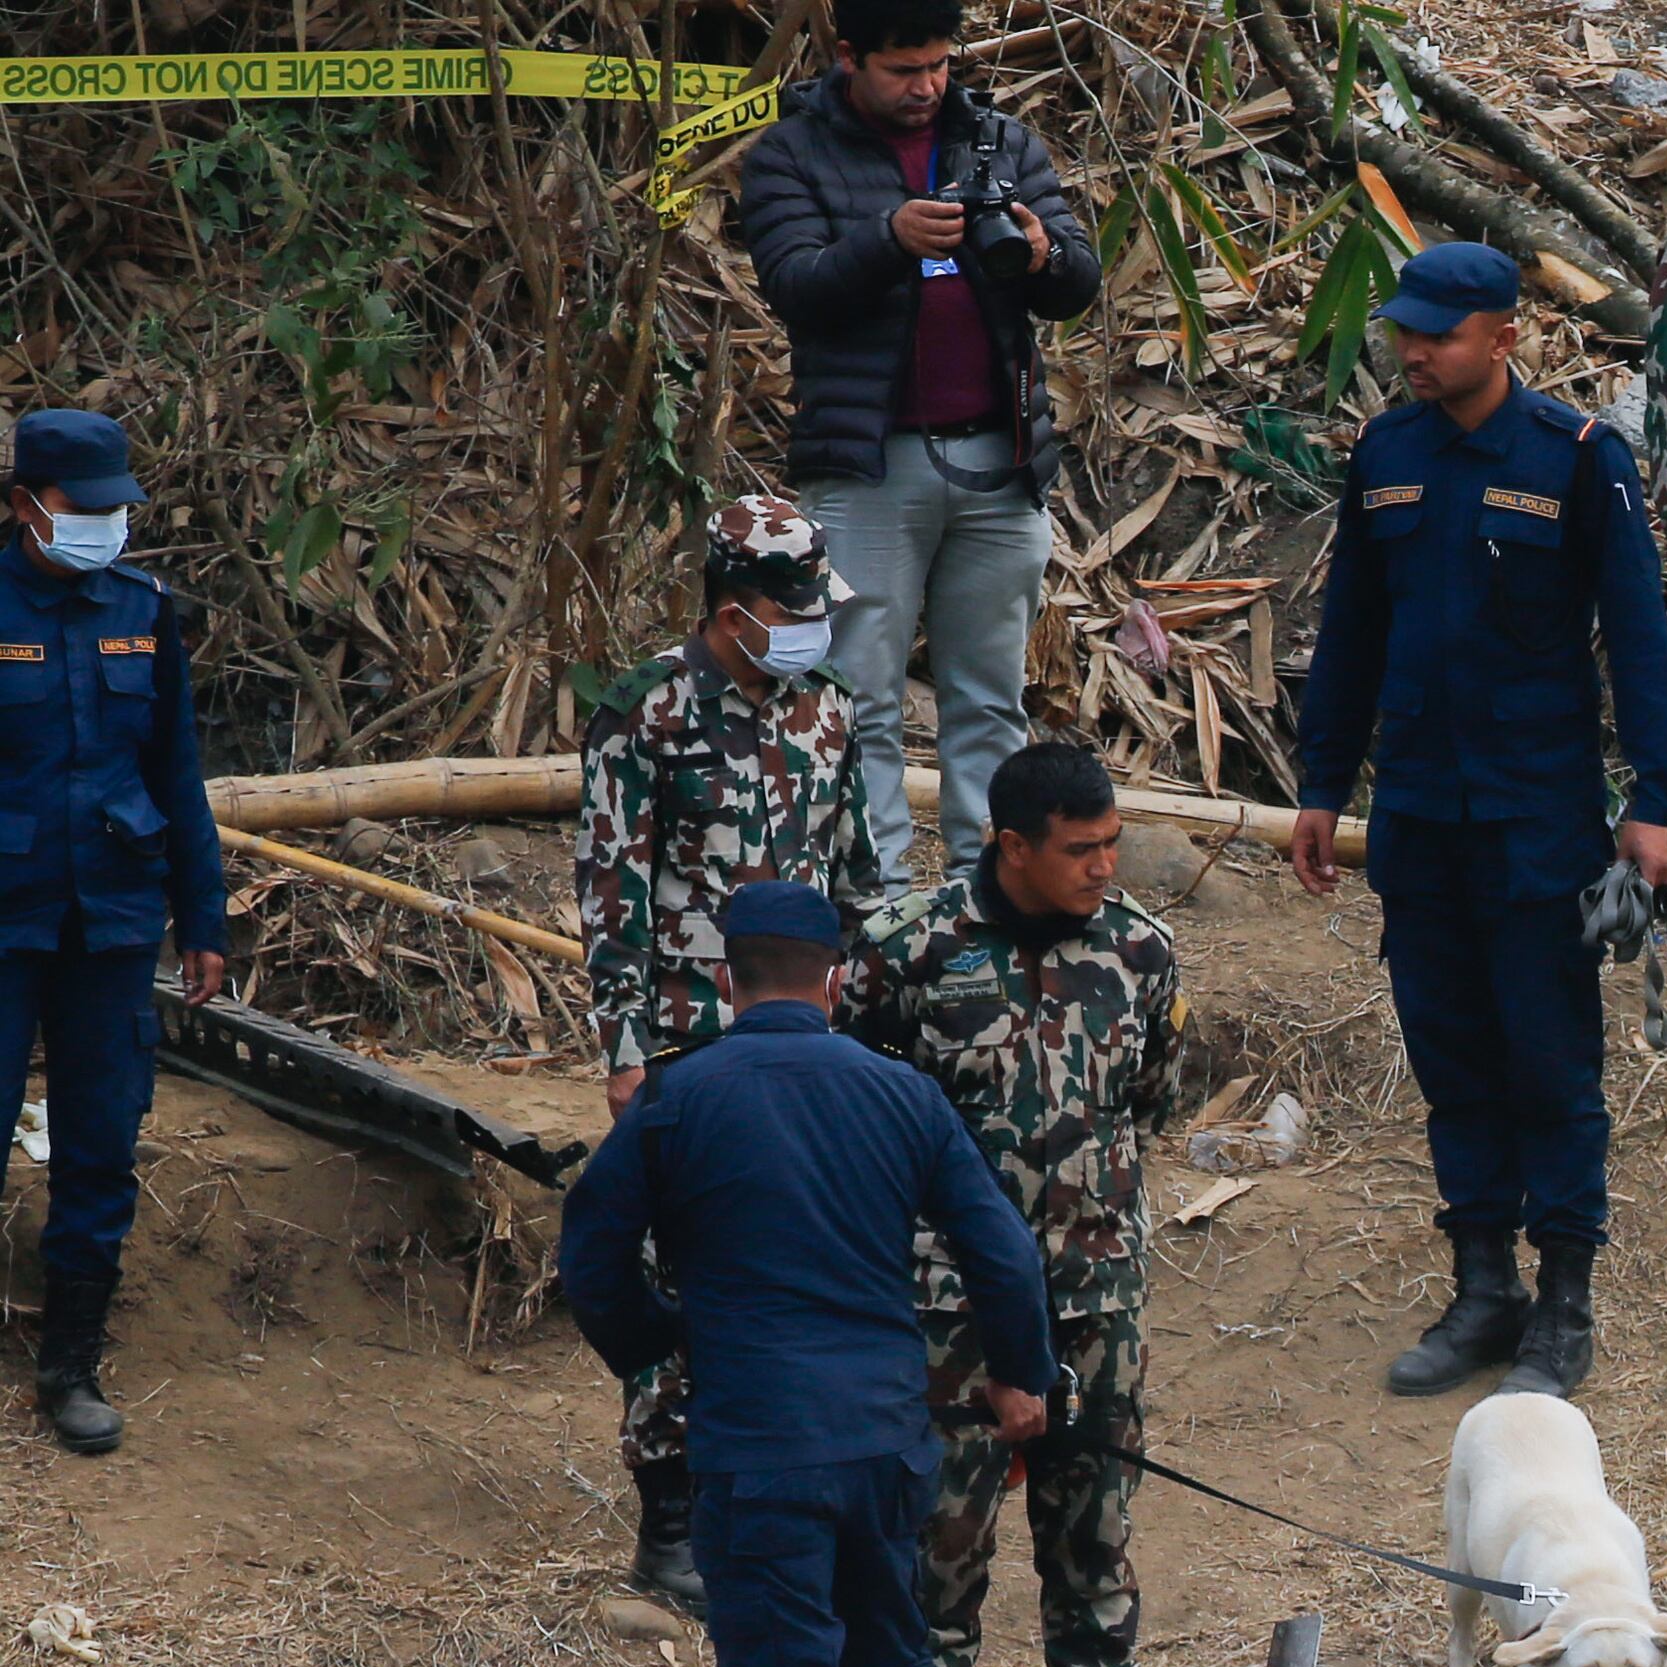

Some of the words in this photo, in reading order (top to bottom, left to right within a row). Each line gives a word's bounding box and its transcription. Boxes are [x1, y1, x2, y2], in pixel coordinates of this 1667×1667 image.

[1487, 491, 1519, 506] NEPAL
[1519, 497, 1556, 514] POLICE
[134, 639, 155, 649] POLI
